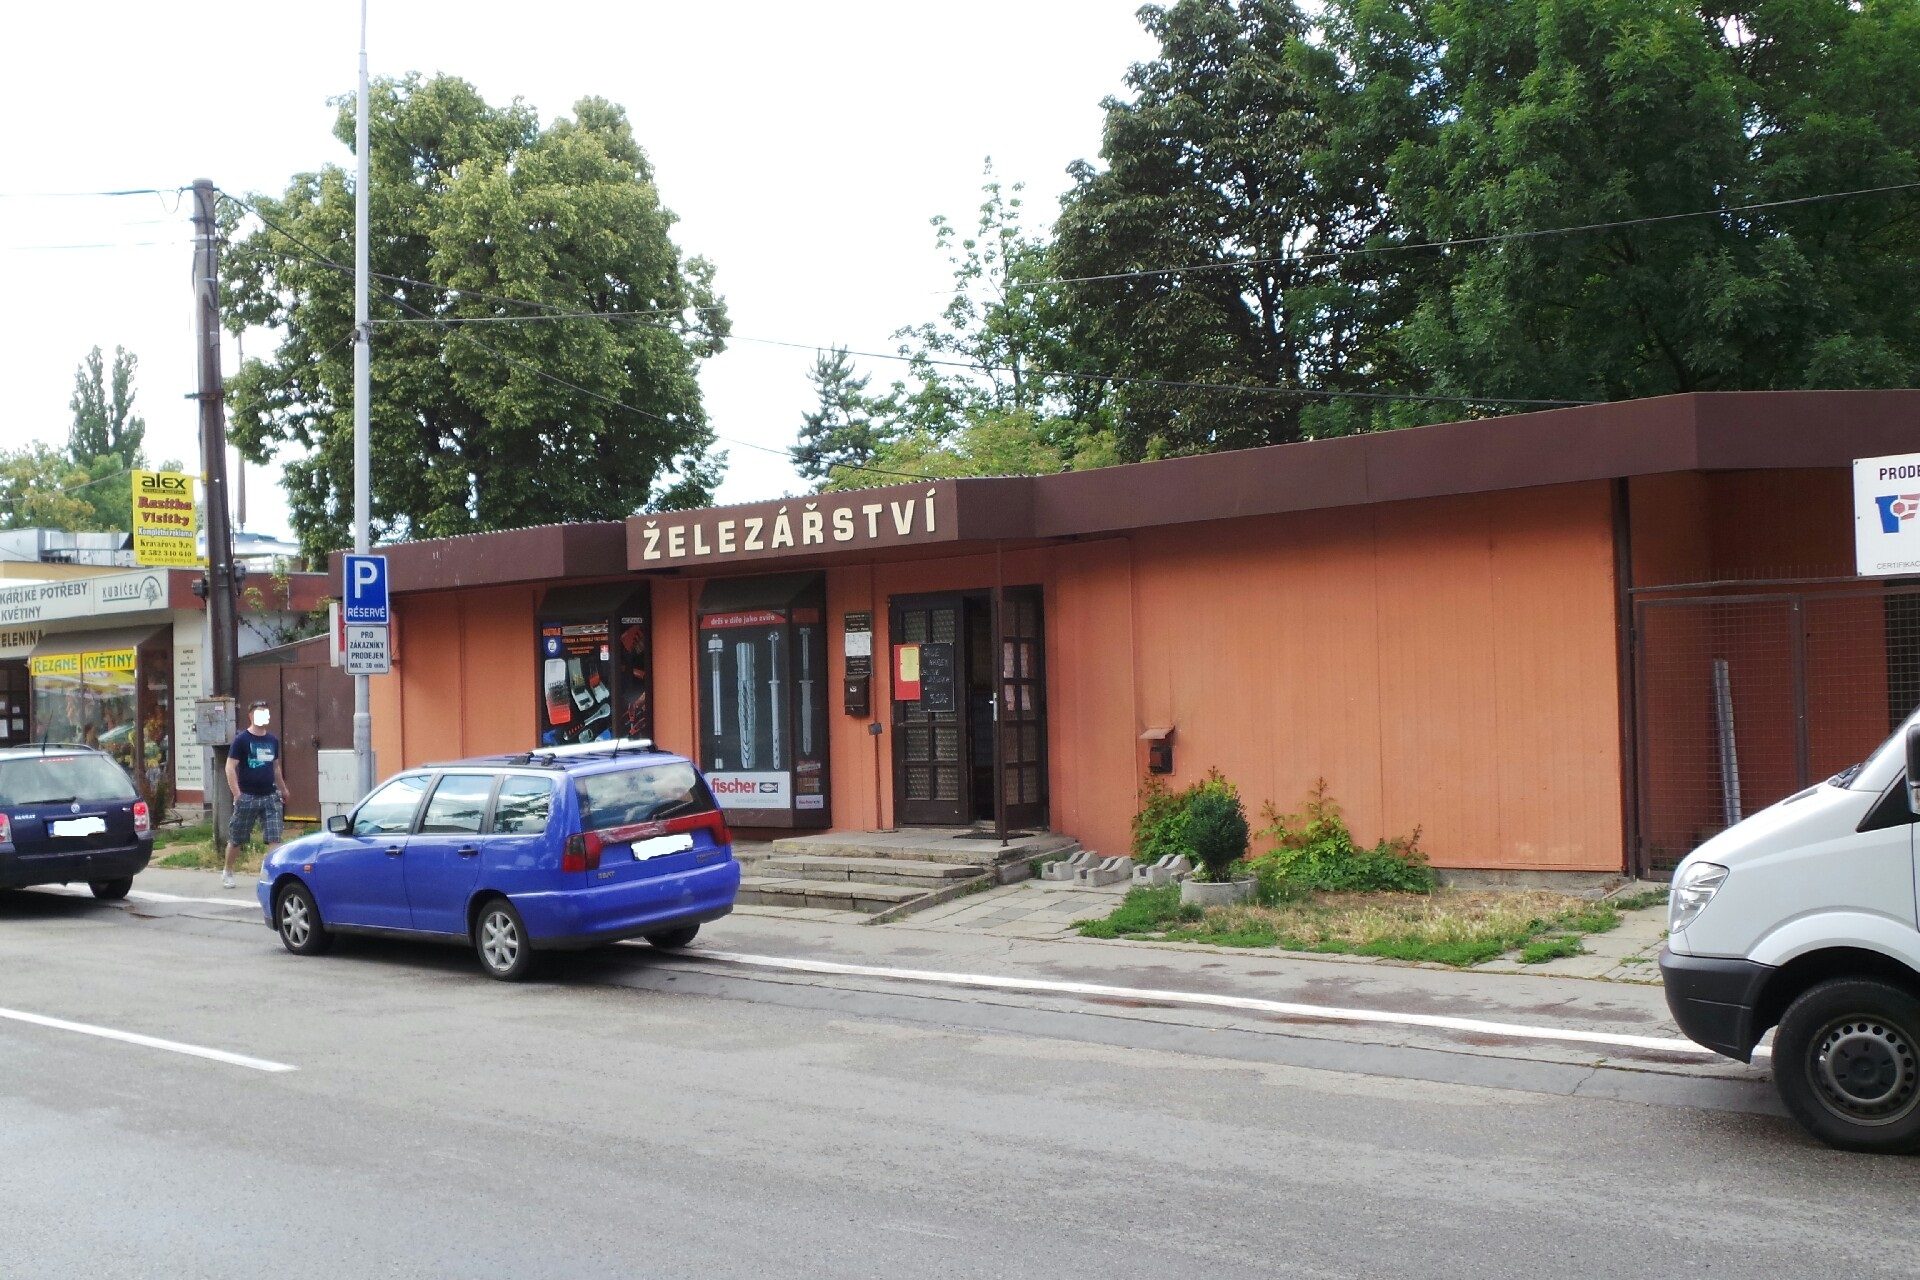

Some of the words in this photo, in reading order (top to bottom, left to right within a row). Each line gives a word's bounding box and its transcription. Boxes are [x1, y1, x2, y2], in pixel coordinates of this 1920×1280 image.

[141, 473, 186, 489] alex
[138, 496, 192, 510] Razítka
[643, 487, 936, 560] ŽELEZÁŘSTVÍ
[354, 560, 378, 599] P
[40, 582, 88, 600] POTŘEBY
[102, 582, 139, 598] KUBÍČEK
[1, 605, 41, 621] KVĚTINY
[347, 606, 385, 618] RÉSERVÉ
[743, 615, 758, 624] jako
[360, 631, 374, 639] PRO
[349, 640, 385, 649] ZÁKAZNÍKY
[34, 655, 78, 673] ŘEZANÉ
[84, 652, 133, 670] KVĚTINY
[351, 652, 384, 660] PRODEJEN
[711, 778, 756, 794] fischer
